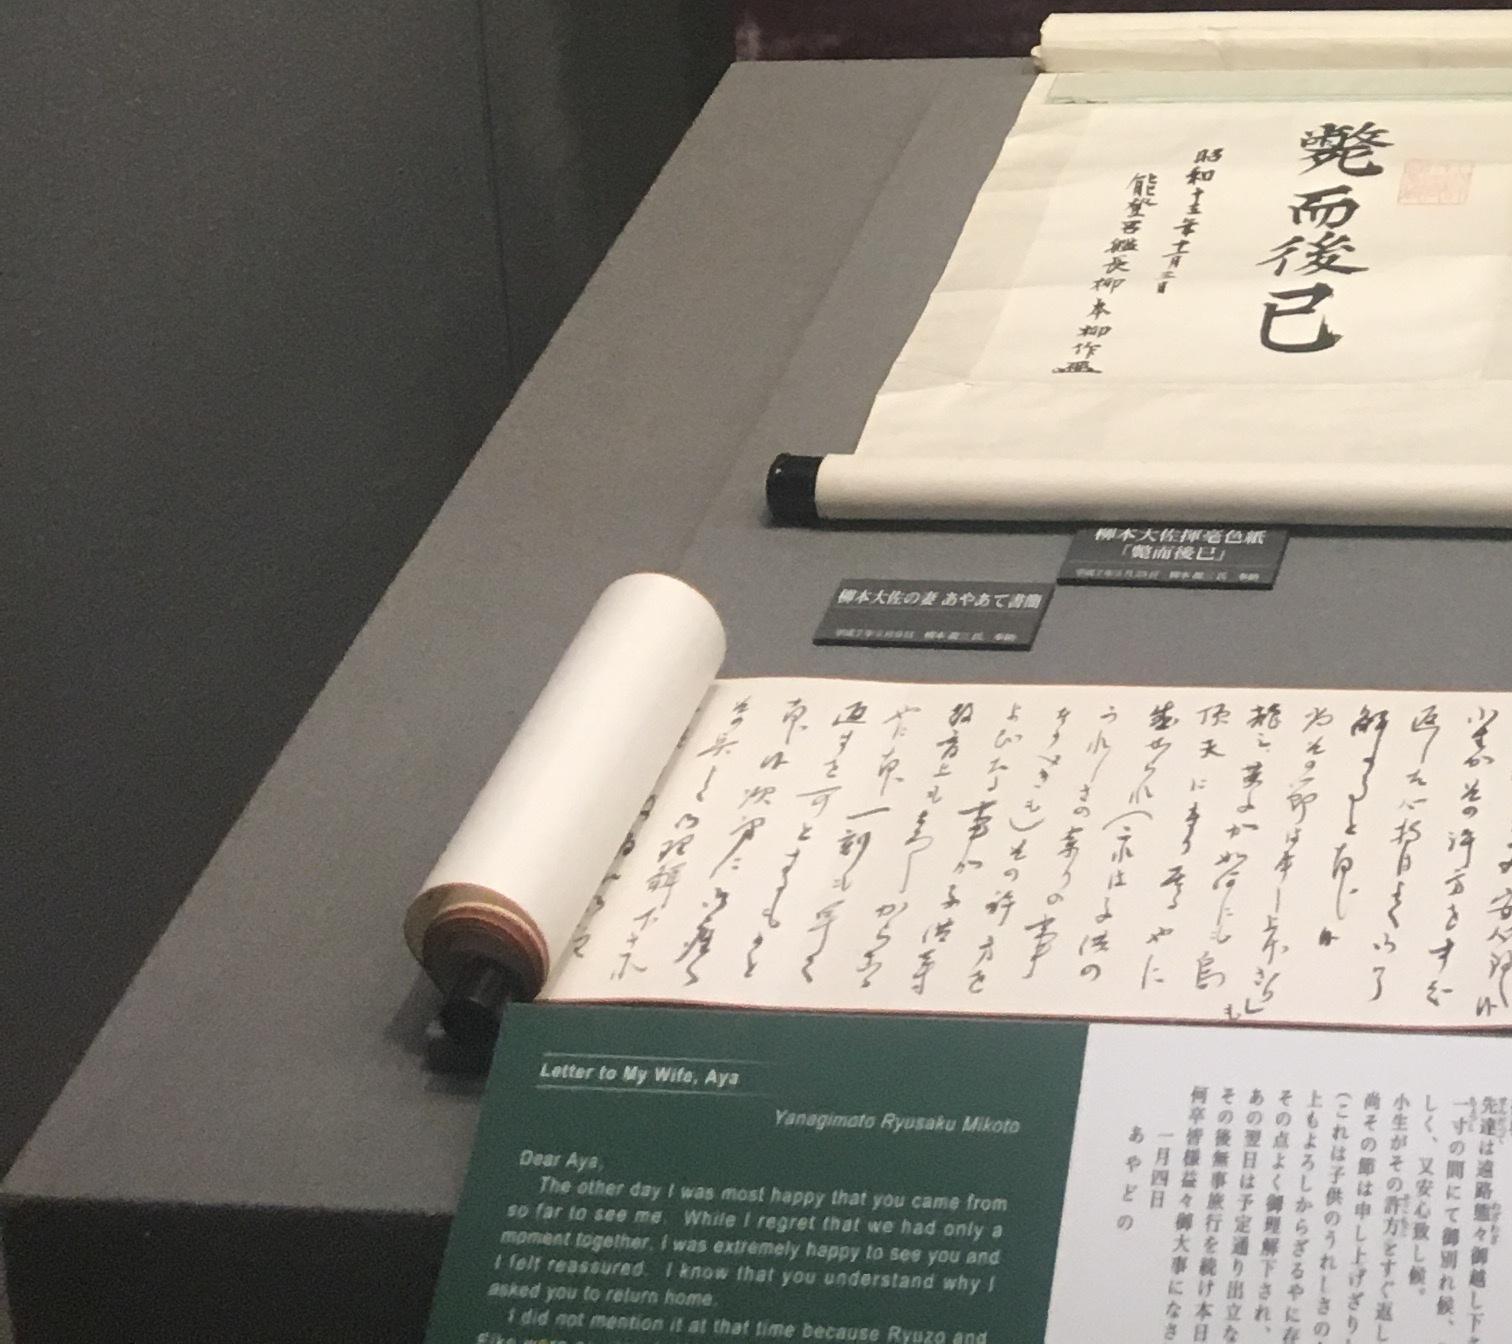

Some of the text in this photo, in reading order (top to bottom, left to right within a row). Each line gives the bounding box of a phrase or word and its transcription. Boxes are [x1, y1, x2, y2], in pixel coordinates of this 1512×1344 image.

[540, 1063, 595, 1079] Letter
[598, 1065, 618, 1080] to
[623, 1065, 648, 1085] My
[704, 1069, 740, 1087] Aya
[1117, 1125, 1144, 1233] あやどの
